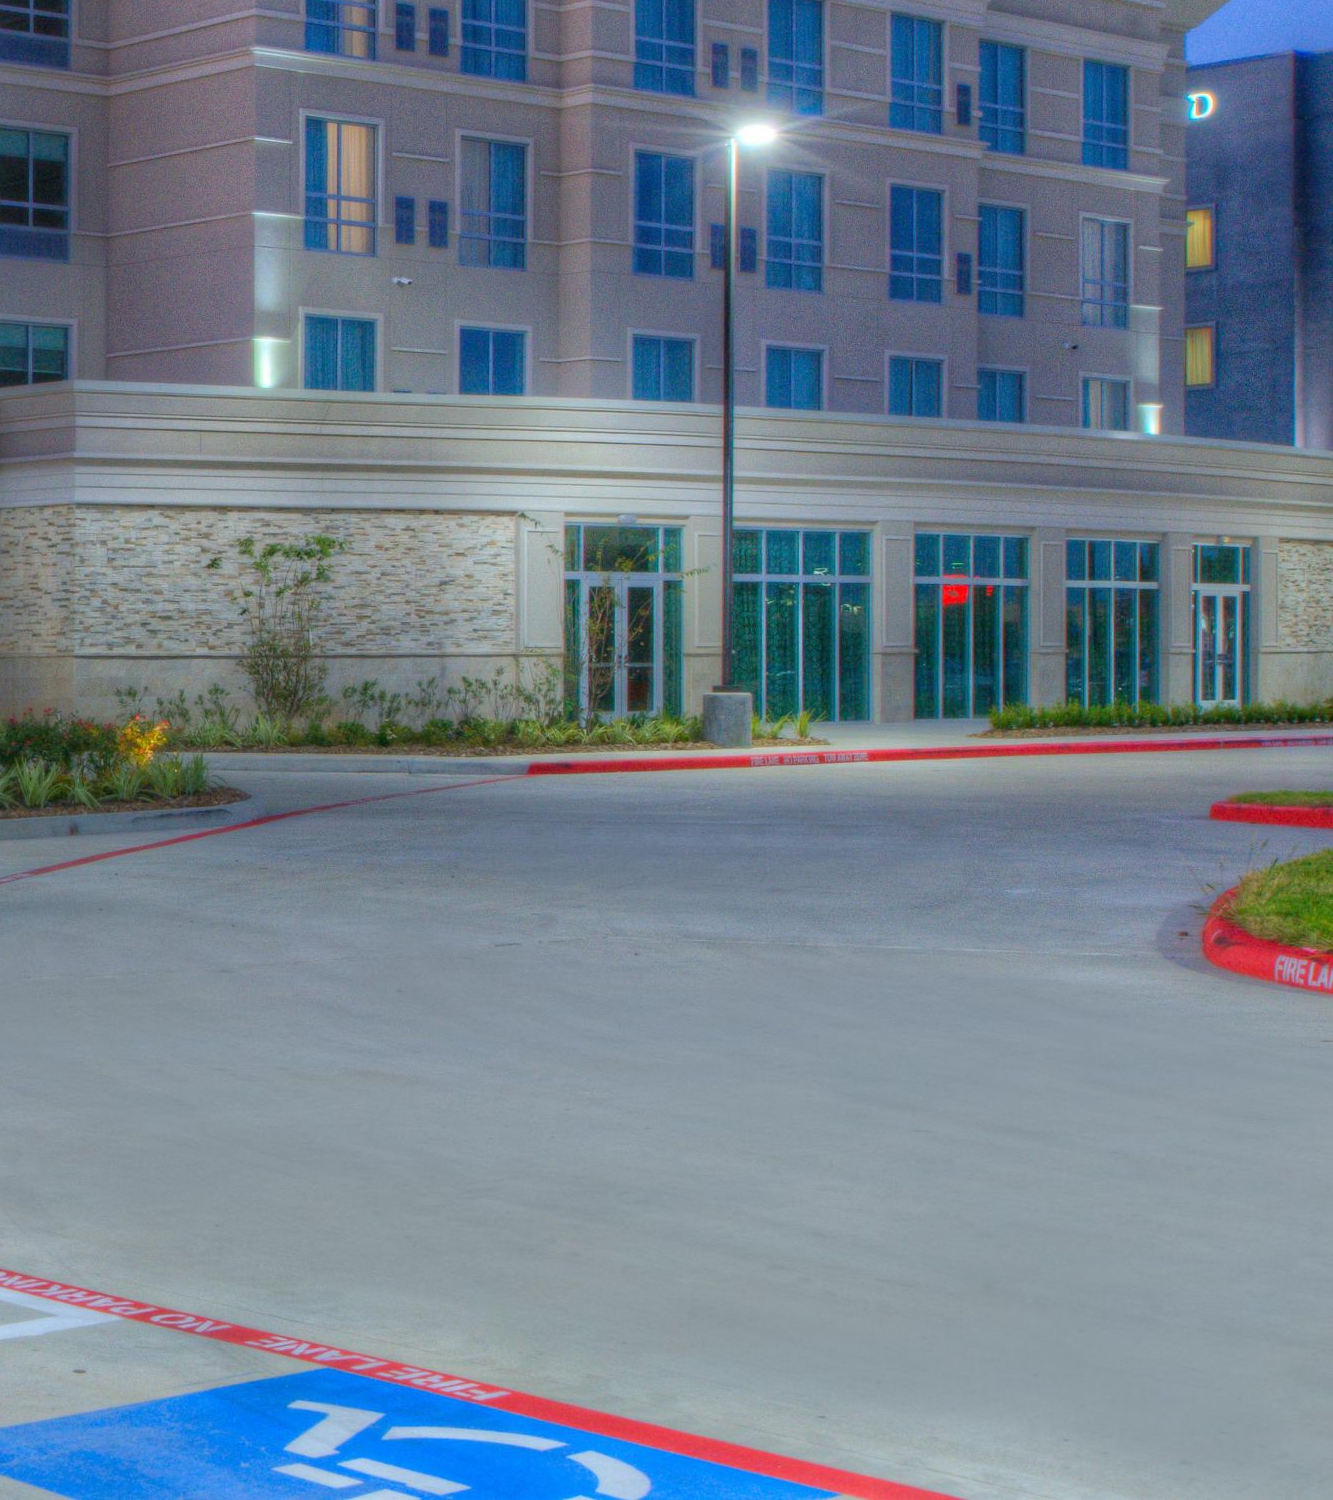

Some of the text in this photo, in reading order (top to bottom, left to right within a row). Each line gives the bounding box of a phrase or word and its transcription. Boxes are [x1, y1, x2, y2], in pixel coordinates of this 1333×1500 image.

[1274, 955, 1307, 984] FIRE
[150, 1314, 232, 1333] NO
[245, 1336, 389, 1371] LANE
[375, 1367, 511, 1401] FIRE
